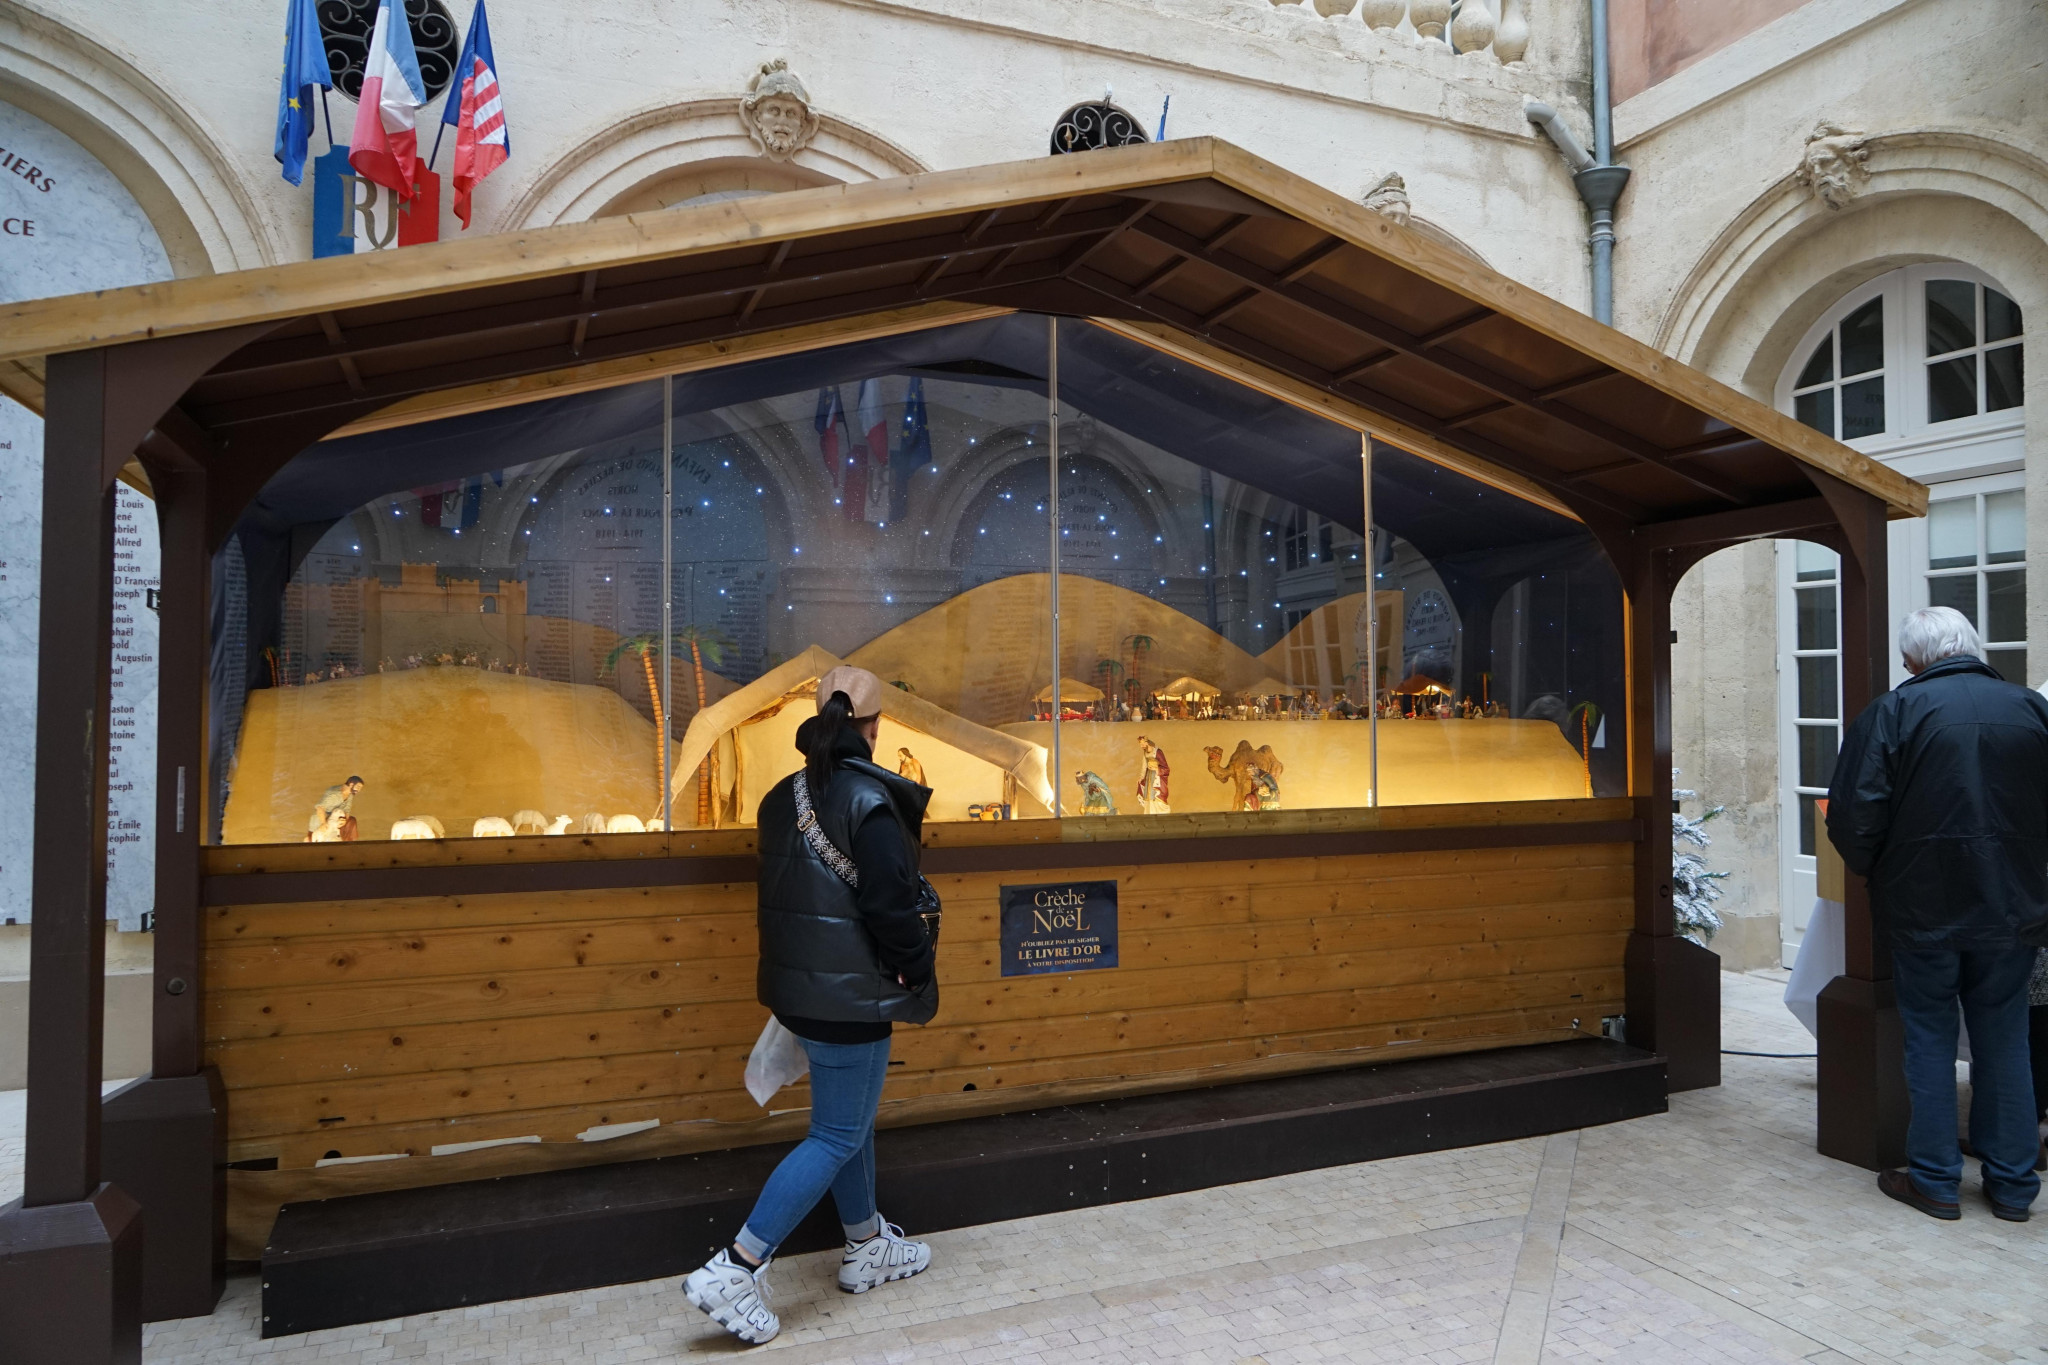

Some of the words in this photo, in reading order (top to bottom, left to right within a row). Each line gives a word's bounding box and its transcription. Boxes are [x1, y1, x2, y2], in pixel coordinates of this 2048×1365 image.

[121, 499, 144, 509] Louis
[115, 538, 142, 547] Alfred
[124, 576, 161, 588] François
[113, 589, 141, 600] oseph
[115, 653, 153, 664] Augustin
[112, 705, 135, 714] aston
[112, 717, 136, 726] Louis
[109, 730, 136, 740] ntoine
[108, 781, 134, 792] oseph
[118, 818, 141, 830] Émile
[109, 832, 141, 845] éophile
[1034, 888, 1086, 908] Crèche
[1018, 950, 1033, 960] LE
[1035, 947, 1070, 959] LIVRE
[1072, 944, 1102, 955] D'OR
[1033, 960, 1053, 968] VOTRE
[853, 1237, 918, 1272] AIR
[706, 1260, 770, 1331] AIR
